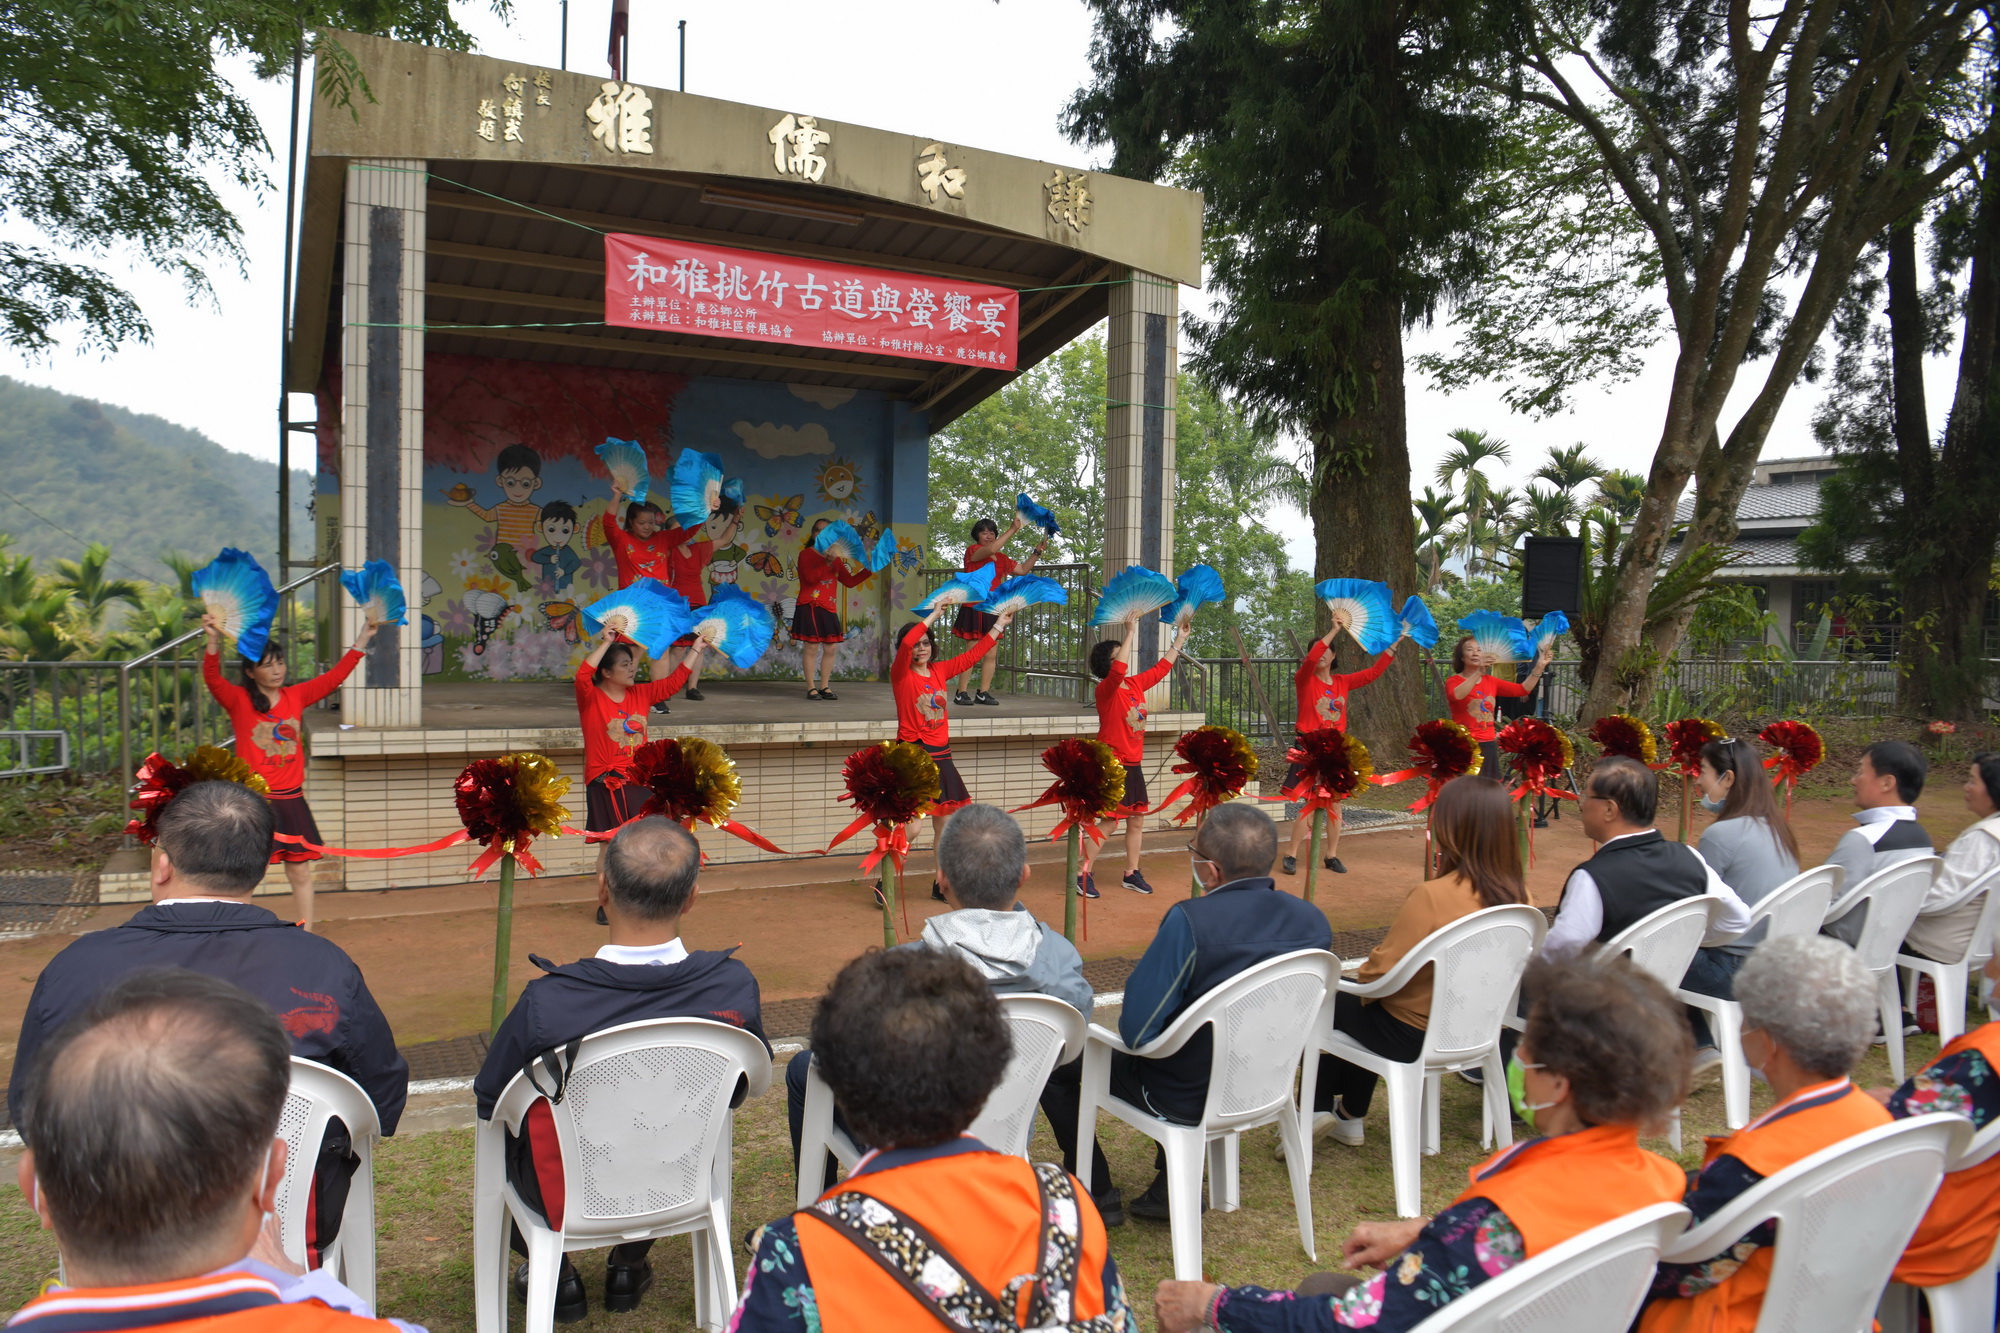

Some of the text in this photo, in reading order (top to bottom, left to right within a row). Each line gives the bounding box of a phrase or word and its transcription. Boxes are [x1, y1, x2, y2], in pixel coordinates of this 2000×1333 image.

[626, 251, 1006, 338] 和雅挑竹古道與螢饗宴
